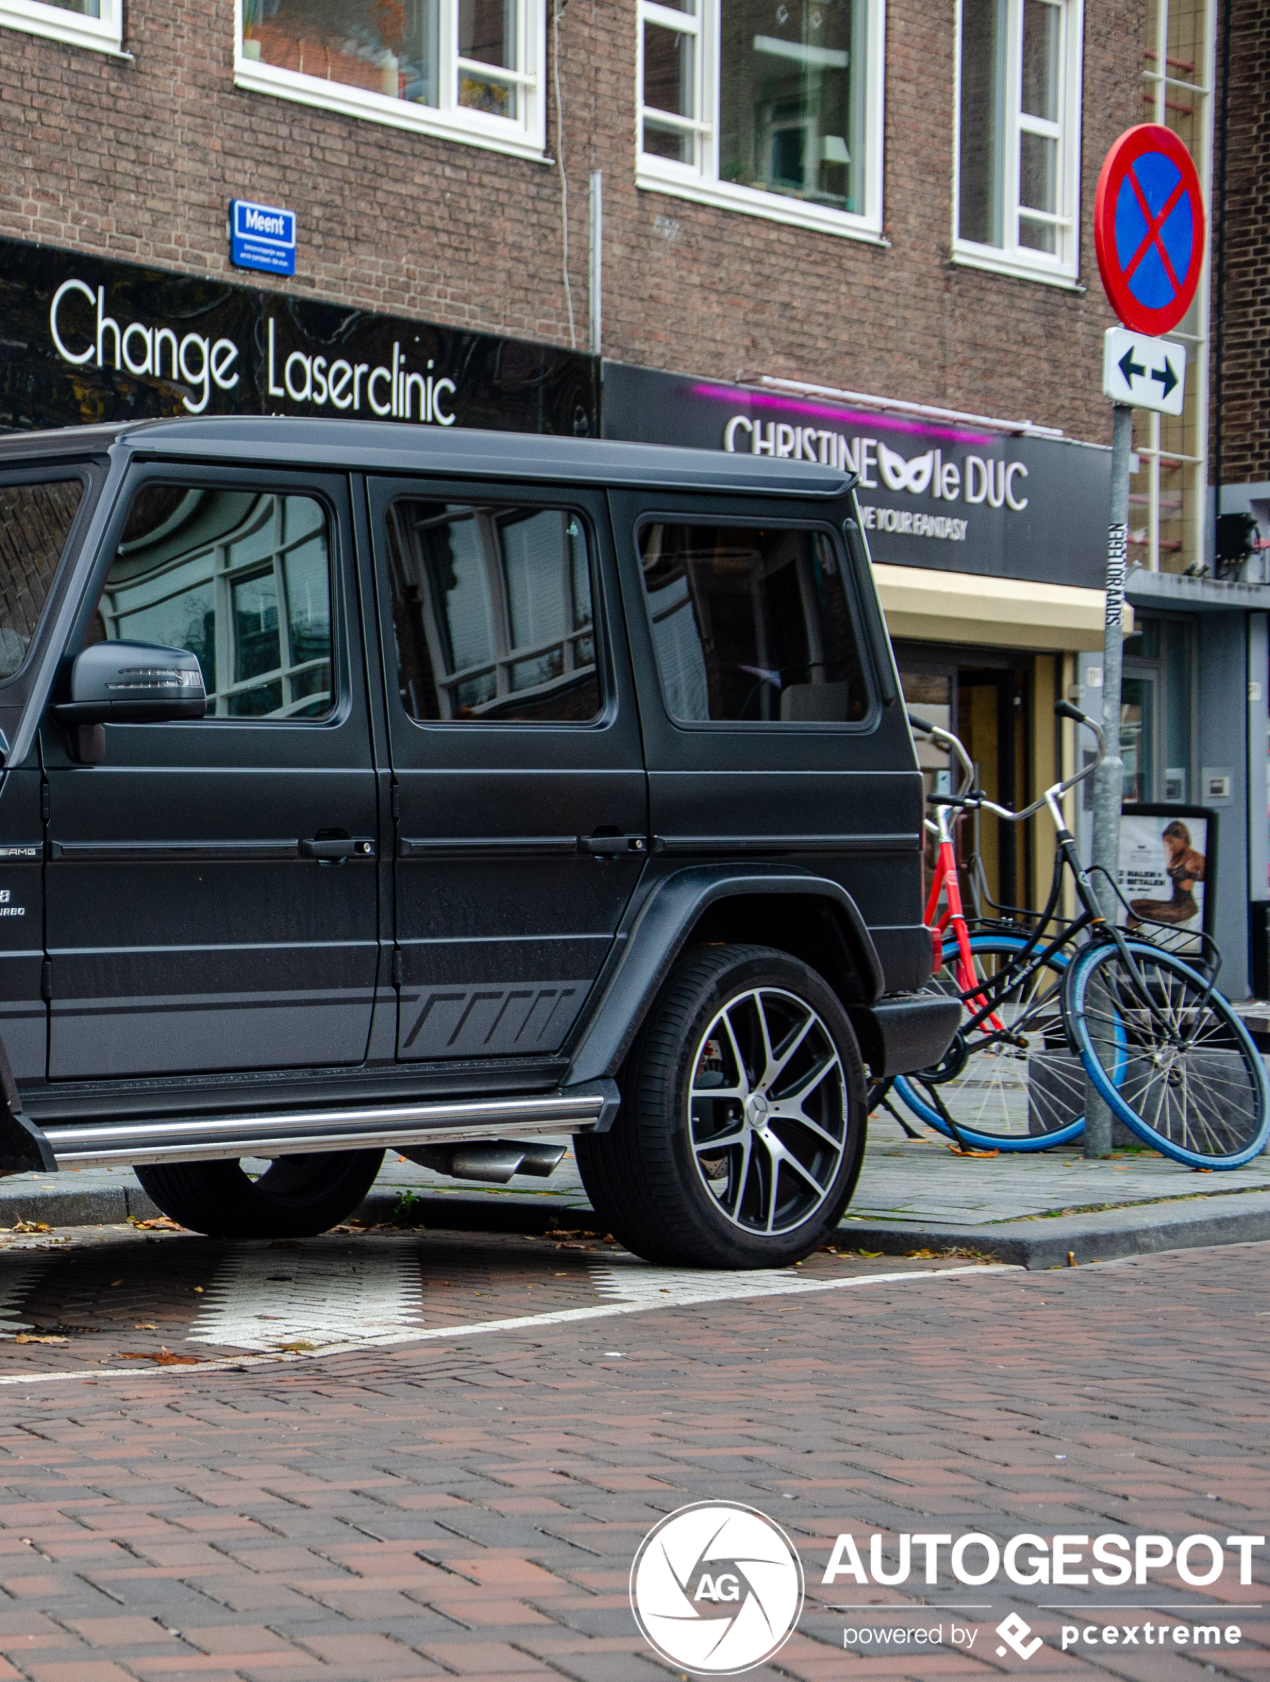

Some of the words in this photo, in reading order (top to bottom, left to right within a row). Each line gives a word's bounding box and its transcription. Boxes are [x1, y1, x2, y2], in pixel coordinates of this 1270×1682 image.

[245, 208, 285, 235] Meent
[50, 279, 239, 414] Change
[268, 317, 457, 426] Laserclinic
[724, 414, 878, 489] CHRISTINE
[932, 448, 961, 501] le
[965, 454, 1029, 511] DUC
[879, 508, 913, 534] YOUR
[912, 512, 969, 541] FANTASY
[1126, 878, 1166, 886] BETALEN
